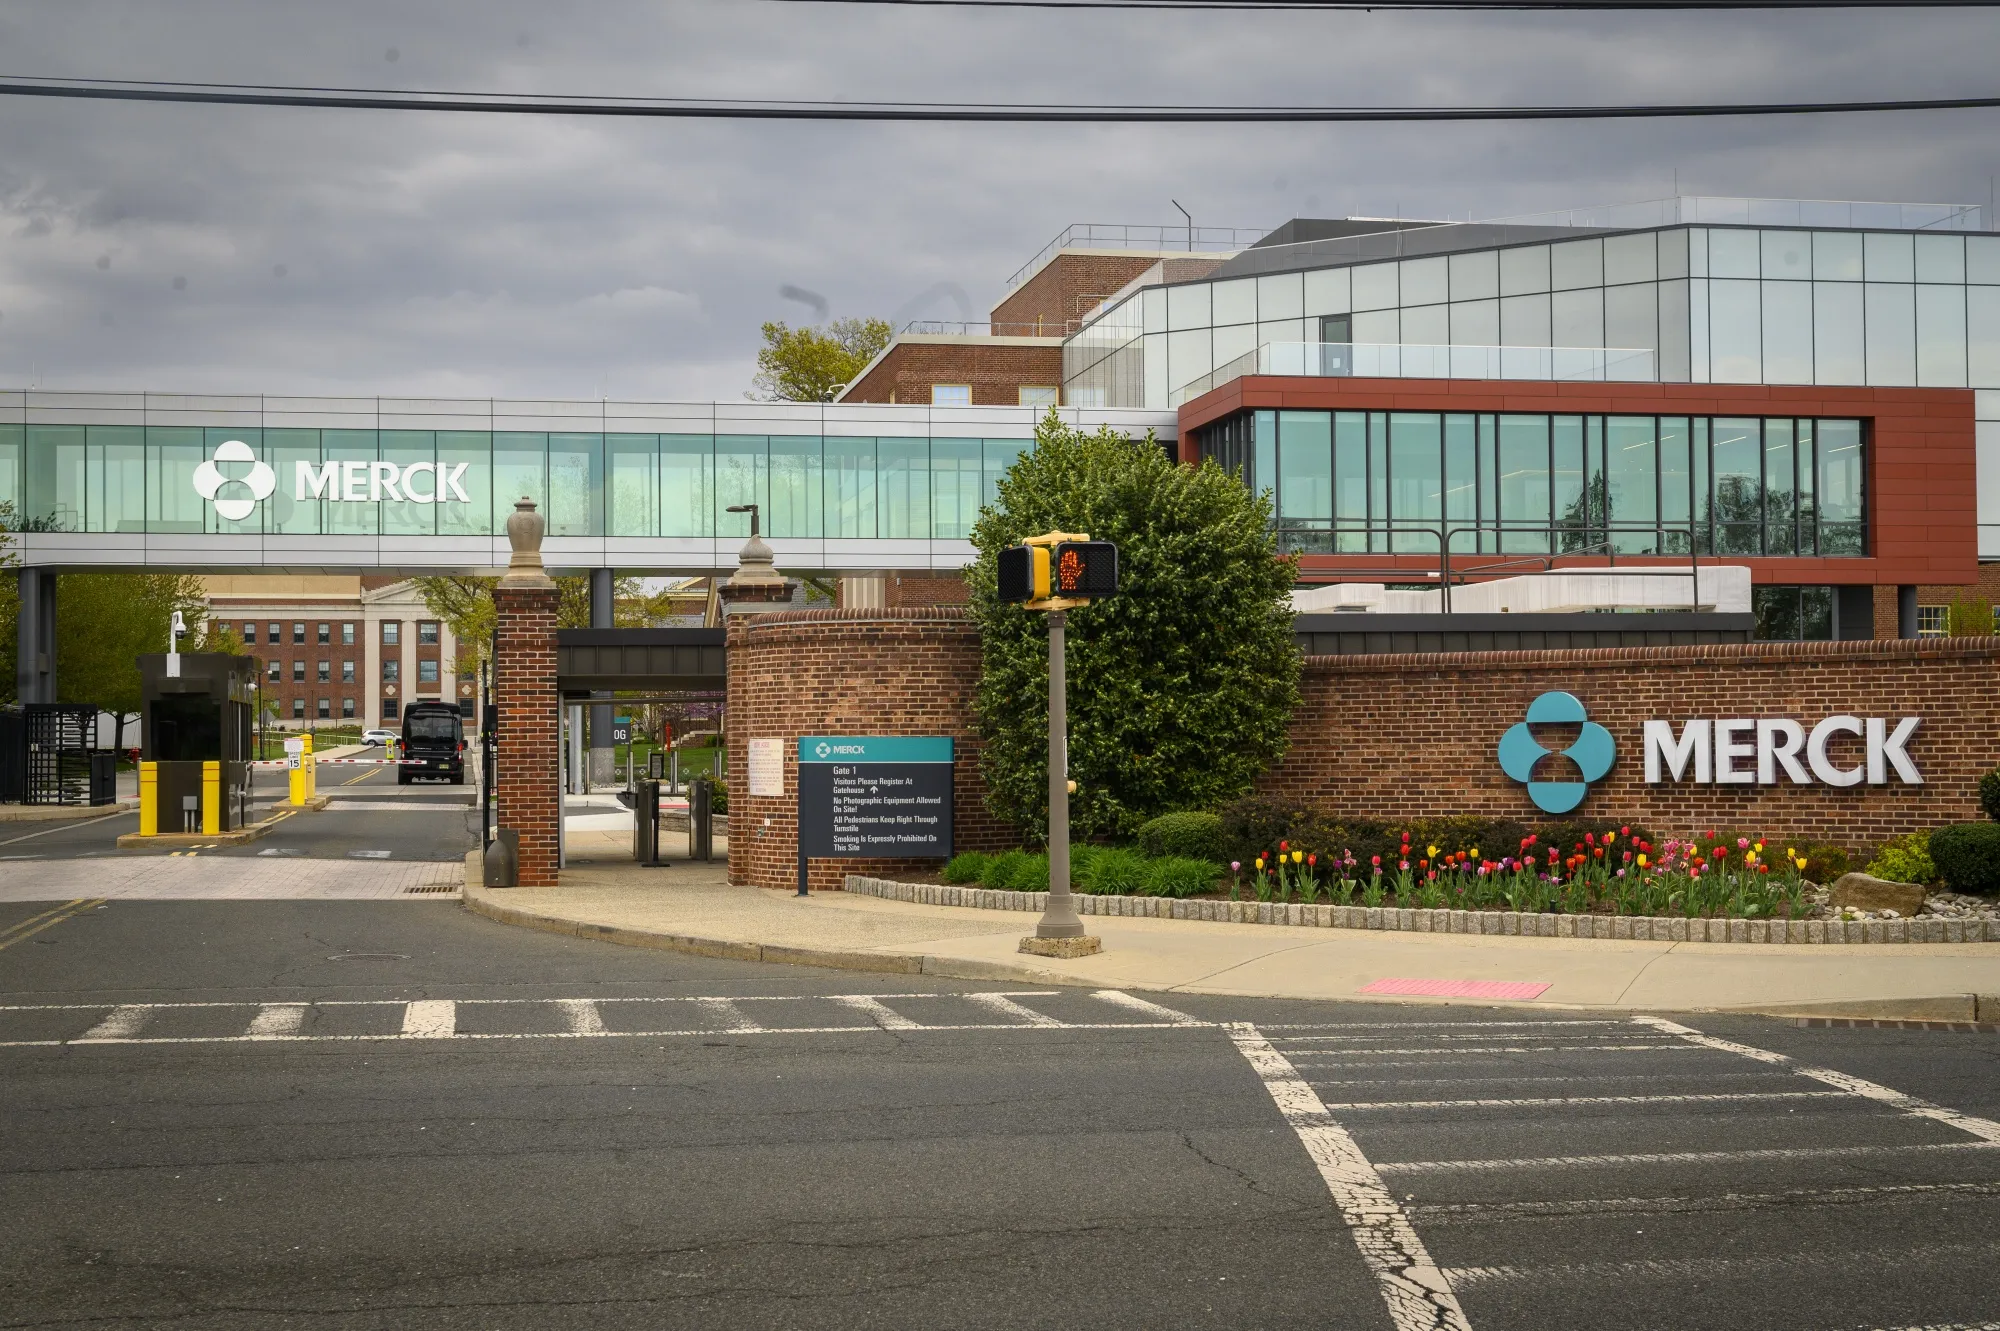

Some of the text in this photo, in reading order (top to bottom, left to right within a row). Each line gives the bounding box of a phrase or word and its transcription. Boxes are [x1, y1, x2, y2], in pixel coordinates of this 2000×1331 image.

[295, 460, 471, 504] MERCK
[833, 745, 865, 754] MERCK
[1643, 715, 1925, 787] MERCK
[833, 766, 856, 774] Gate 1
[880, 778, 904, 786] Register
[844, 797, 882, 806] Photographic
[884, 797, 914, 805] Equipment
[880, 816, 895, 824] Keep
[896, 816, 912, 824] Right
[914, 816, 938, 824] Through
[833, 835, 859, 844] Smoking
[868, 835, 896, 844] Expressly
